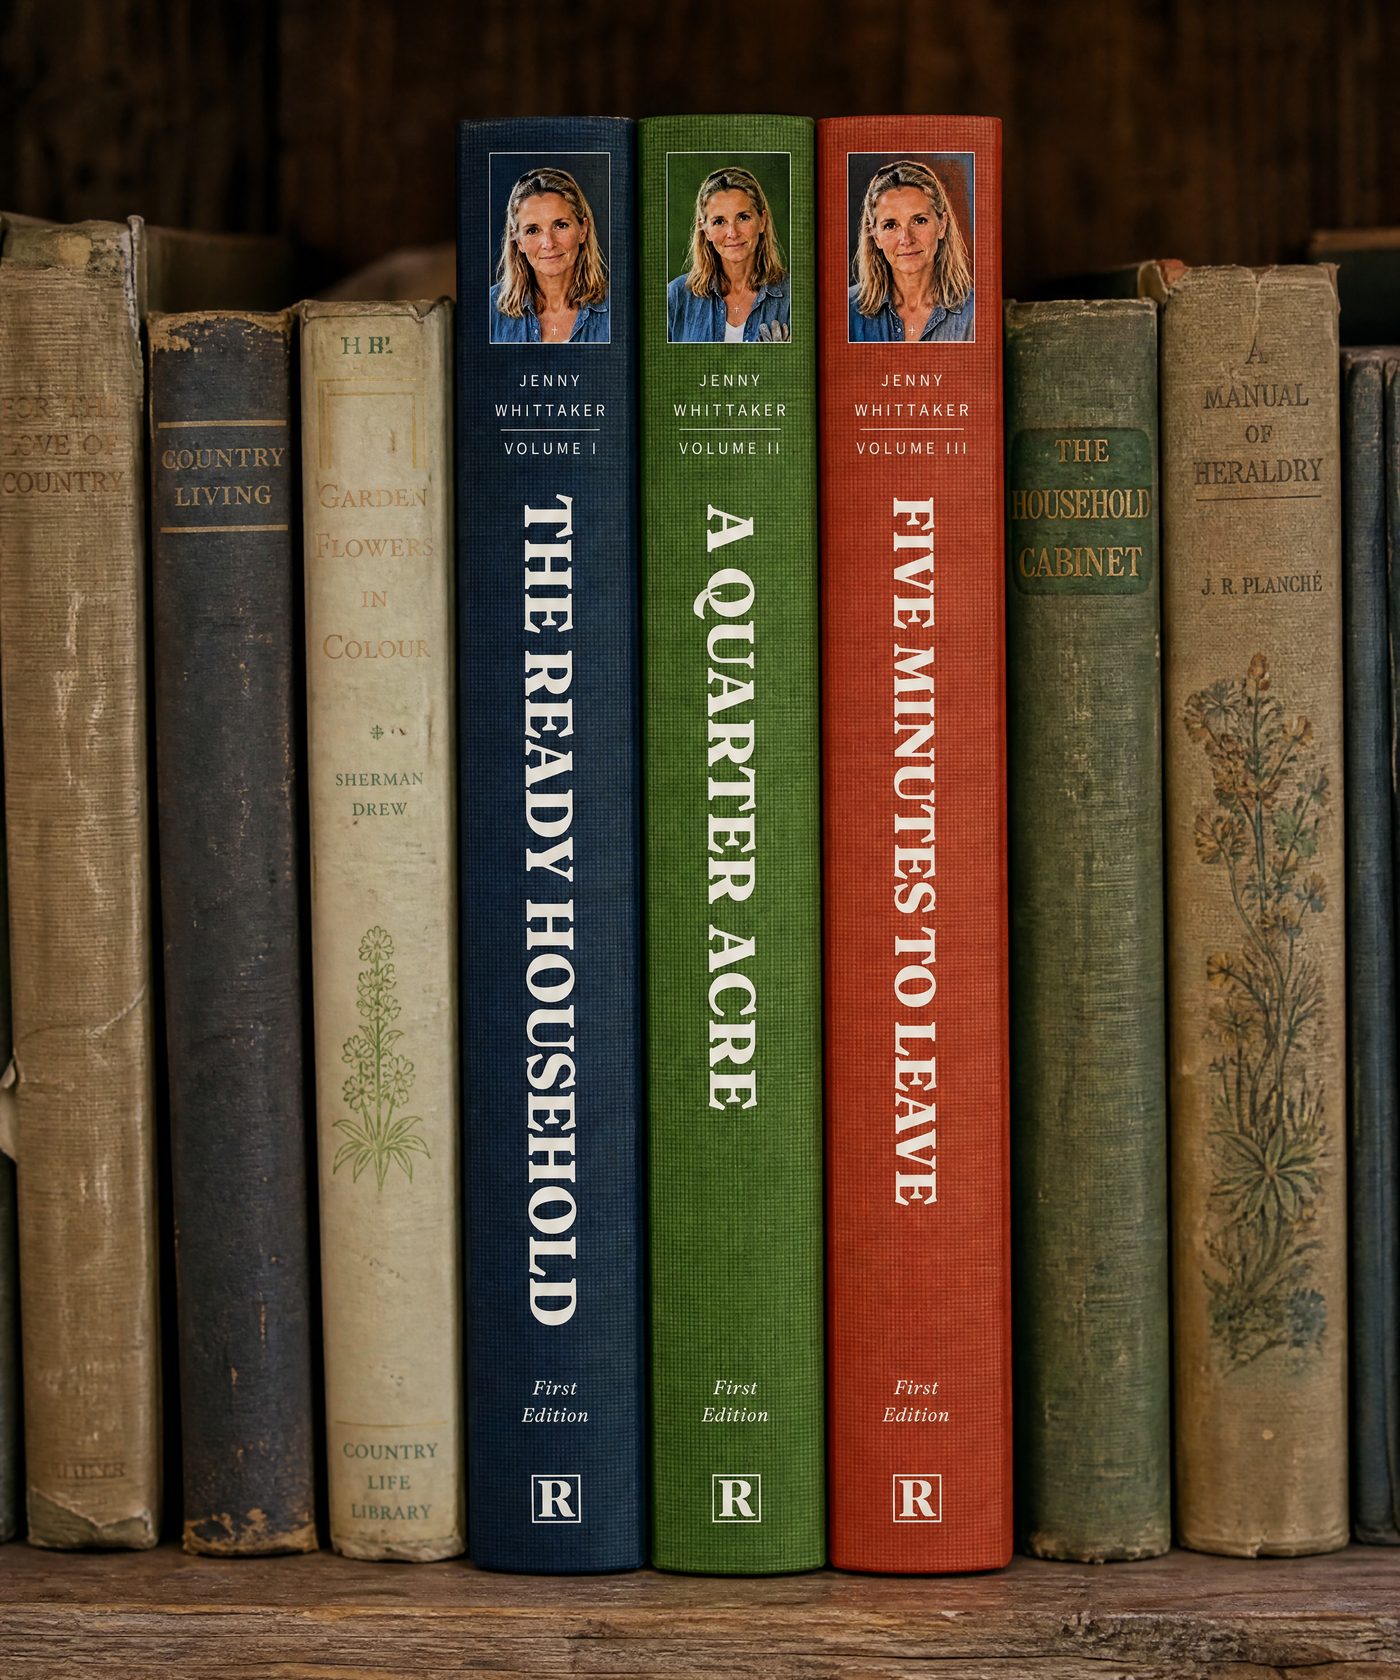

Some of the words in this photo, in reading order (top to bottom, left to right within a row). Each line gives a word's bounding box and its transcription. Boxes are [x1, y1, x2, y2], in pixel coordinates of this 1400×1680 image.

[1244, 338, 1268, 366] A
[519, 373, 581, 388] JENNY
[699, 373, 761, 388] JENNY
[881, 373, 944, 388] JENNY
[1203, 383, 1309, 410] MANUAL
[494, 403, 606, 418] WHITTAKER
[673, 403, 788, 418] WHITTAKER
[854, 403, 970, 418] WHITTAKER
[83, 434, 118, 456] OF
[1245, 425, 1273, 444] OF
[161, 447, 285, 471] COUNTRY
[504, 441, 583, 455] VOLUME
[591, 441, 597, 455] I
[678, 441, 757, 455] VOLUME
[767, 441, 780, 455] II
[856, 441, 936, 455] VOLUME
[946, 441, 968, 455] III
[1055, 438, 1109, 463] THE
[2, 471, 125, 493] COUNTRY
[1193, 458, 1323, 486] HERALDRY
[174, 486, 272, 507] LIVING
[318, 483, 428, 510] GARDEN
[1010, 487, 1151, 522] HOUSEHOLD
[706, 504, 754, 553] A
[315, 532, 434, 560] FLOWERS
[524, 494, 574, 634] THE
[893, 497, 935, 630] FIVE
[1018, 546, 1143, 579] CABINET
[1201, 577, 1214, 596] J.
[1222, 578, 1239, 595] R.
[1243, 569, 1323, 594] PLANCHÉ
[361, 590, 388, 609] IN
[322, 633, 432, 661] COLOUR
[693, 568, 756, 905] QUARTER
[524, 650, 574, 882] READY
[335, 770, 424, 788] SHERMAN
[893, 644, 936, 914] MINUTES
[352, 801, 408, 817] DREW
[894, 927, 937, 1008] TO
[708, 924, 757, 1110] ACRE
[525, 899, 577, 1326] HOUSEHOLD
[894, 1021, 937, 1206] LEAVE
[532, 1379, 578, 1396] First
[713, 1379, 758, 1396] First
[894, 1379, 940, 1396] First
[521, 1407, 589, 1424] Edition
[702, 1407, 769, 1424] Edition
[882, 1407, 950, 1424] Edition
[342, 1441, 439, 1461] COUNTRY
[367, 1474, 411, 1491] LIFE
[538, 1479, 576, 1518] R
[718, 1479, 756, 1518] R
[899, 1479, 937, 1518] R
[351, 1503, 432, 1521] LIBRARY
